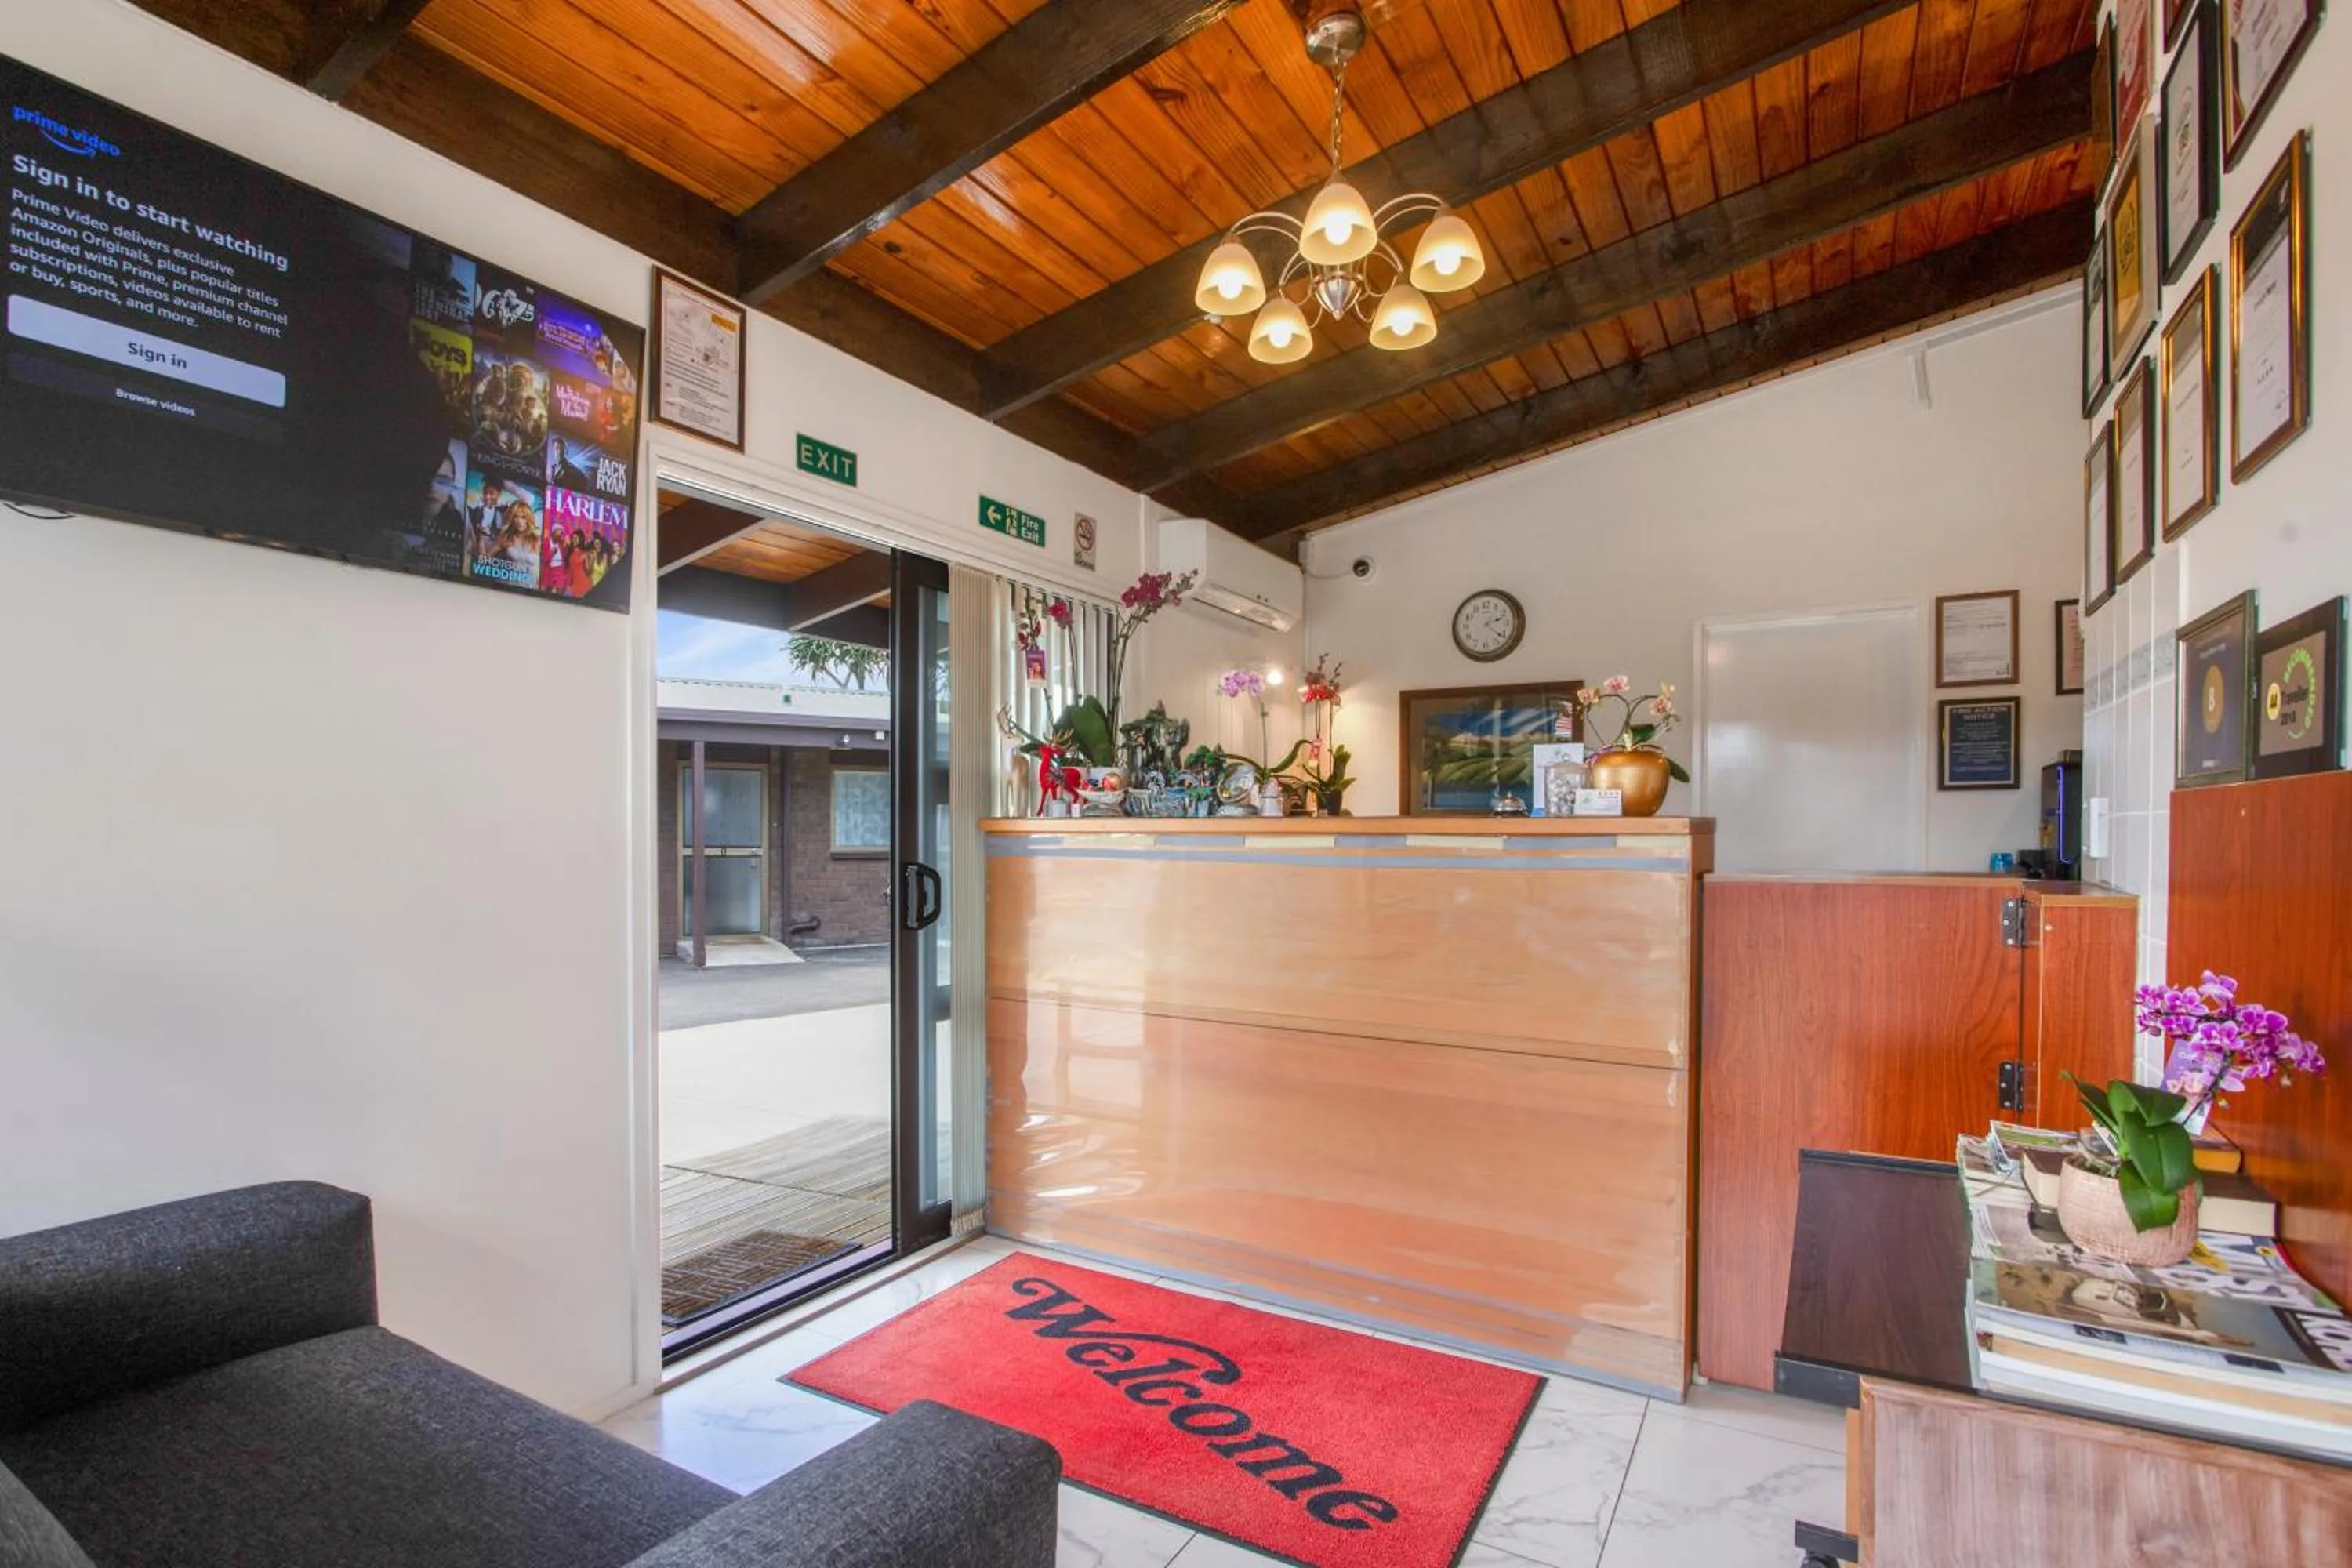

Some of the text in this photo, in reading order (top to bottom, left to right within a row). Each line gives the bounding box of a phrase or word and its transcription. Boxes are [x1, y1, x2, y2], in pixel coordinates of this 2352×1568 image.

[13, 105, 122, 156] prime video
[12, 188, 234, 276] Prime Video delivers exclusive
[13, 154, 289, 272] Sign in to start watching
[11, 207, 279, 307] Amazon Originals, plus popular titles
[11, 223, 289, 325] included with Prime, premium channel
[9, 243, 282, 339] subscriptions, videos available to rent
[9, 260, 29, 274] or
[70, 279, 122, 306] sports,
[125, 297, 154, 314] and
[158, 306, 198, 328] more.
[128, 342, 187, 369] Sign in
[115, 388, 197, 416] Browse videos
[599, 456, 626, 480] JACK
[800, 442, 853, 477] EXIT
[597, 471, 626, 496] RYAN
[546, 487, 628, 530] HARLEM
[1021, 514, 1039, 531] Fire
[1021, 527, 1040, 543] Exit
[473, 562, 533, 583] WEDDING
[1004, 1276, 1399, 1531] Welcome
